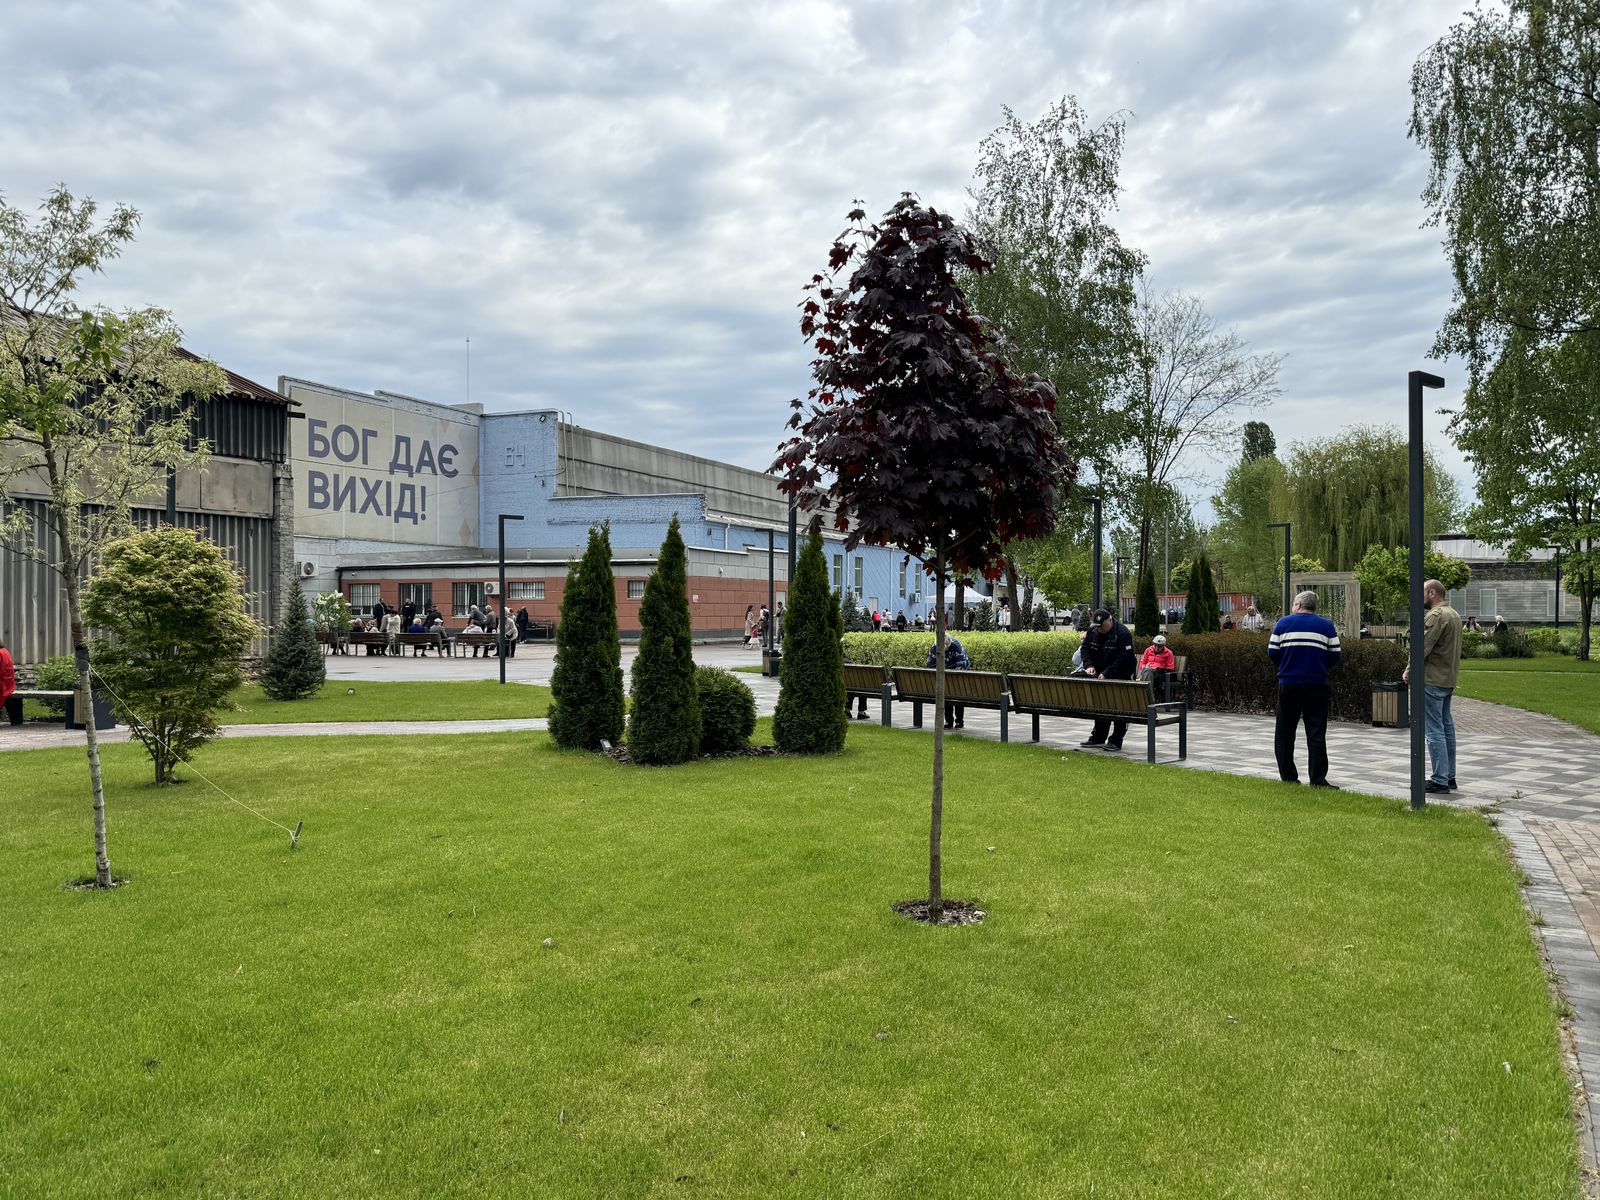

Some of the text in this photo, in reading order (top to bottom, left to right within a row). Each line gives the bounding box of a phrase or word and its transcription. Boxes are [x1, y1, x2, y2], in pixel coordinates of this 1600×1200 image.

[308, 418, 459, 478] БОГ ДАЄ
[308, 470, 427, 525] ВИХІД!
